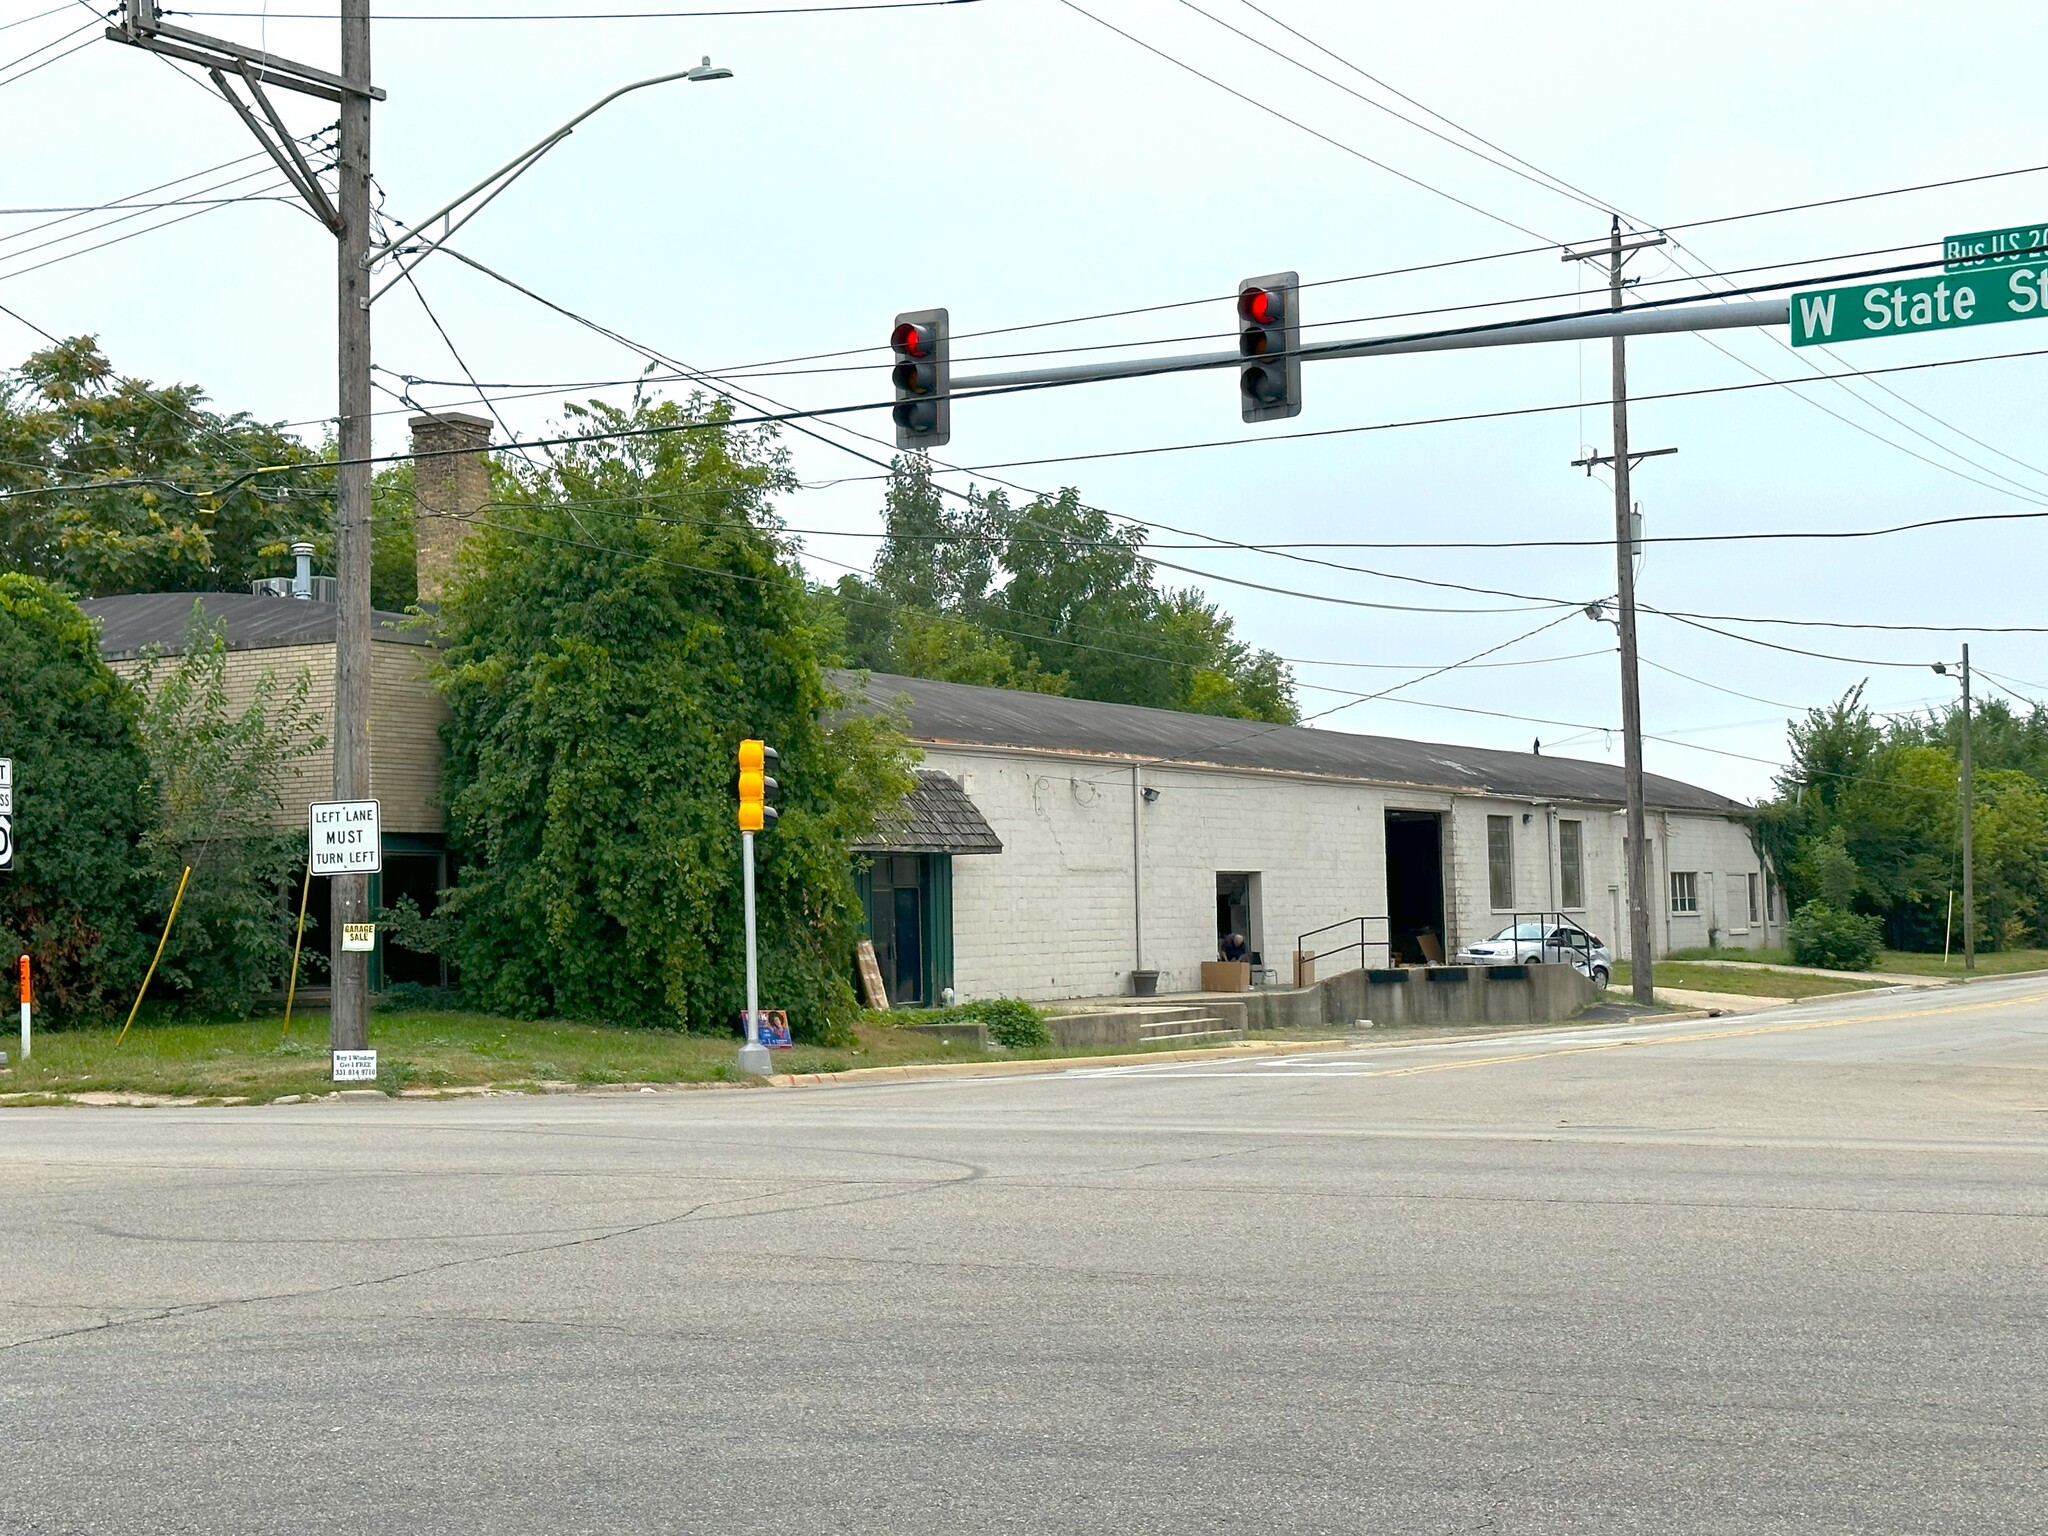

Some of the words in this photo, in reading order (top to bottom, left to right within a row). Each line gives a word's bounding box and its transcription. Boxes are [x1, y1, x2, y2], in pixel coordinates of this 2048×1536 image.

[1948, 242, 1985, 268] Bus
[1992, 232, 2020, 262] US
[1800, 295, 1836, 338] W
[1863, 281, 1976, 331] State
[2008, 267, 2048, 313] St
[316, 812, 340, 823] LEFT
[346, 810, 373, 822] LANE
[327, 830, 363, 844] MUST
[316, 853, 343, 865] TURN
[349, 851, 374, 863] LEFT
[344, 925, 374, 933] GARAGE
[350, 933, 368, 941] SALE
